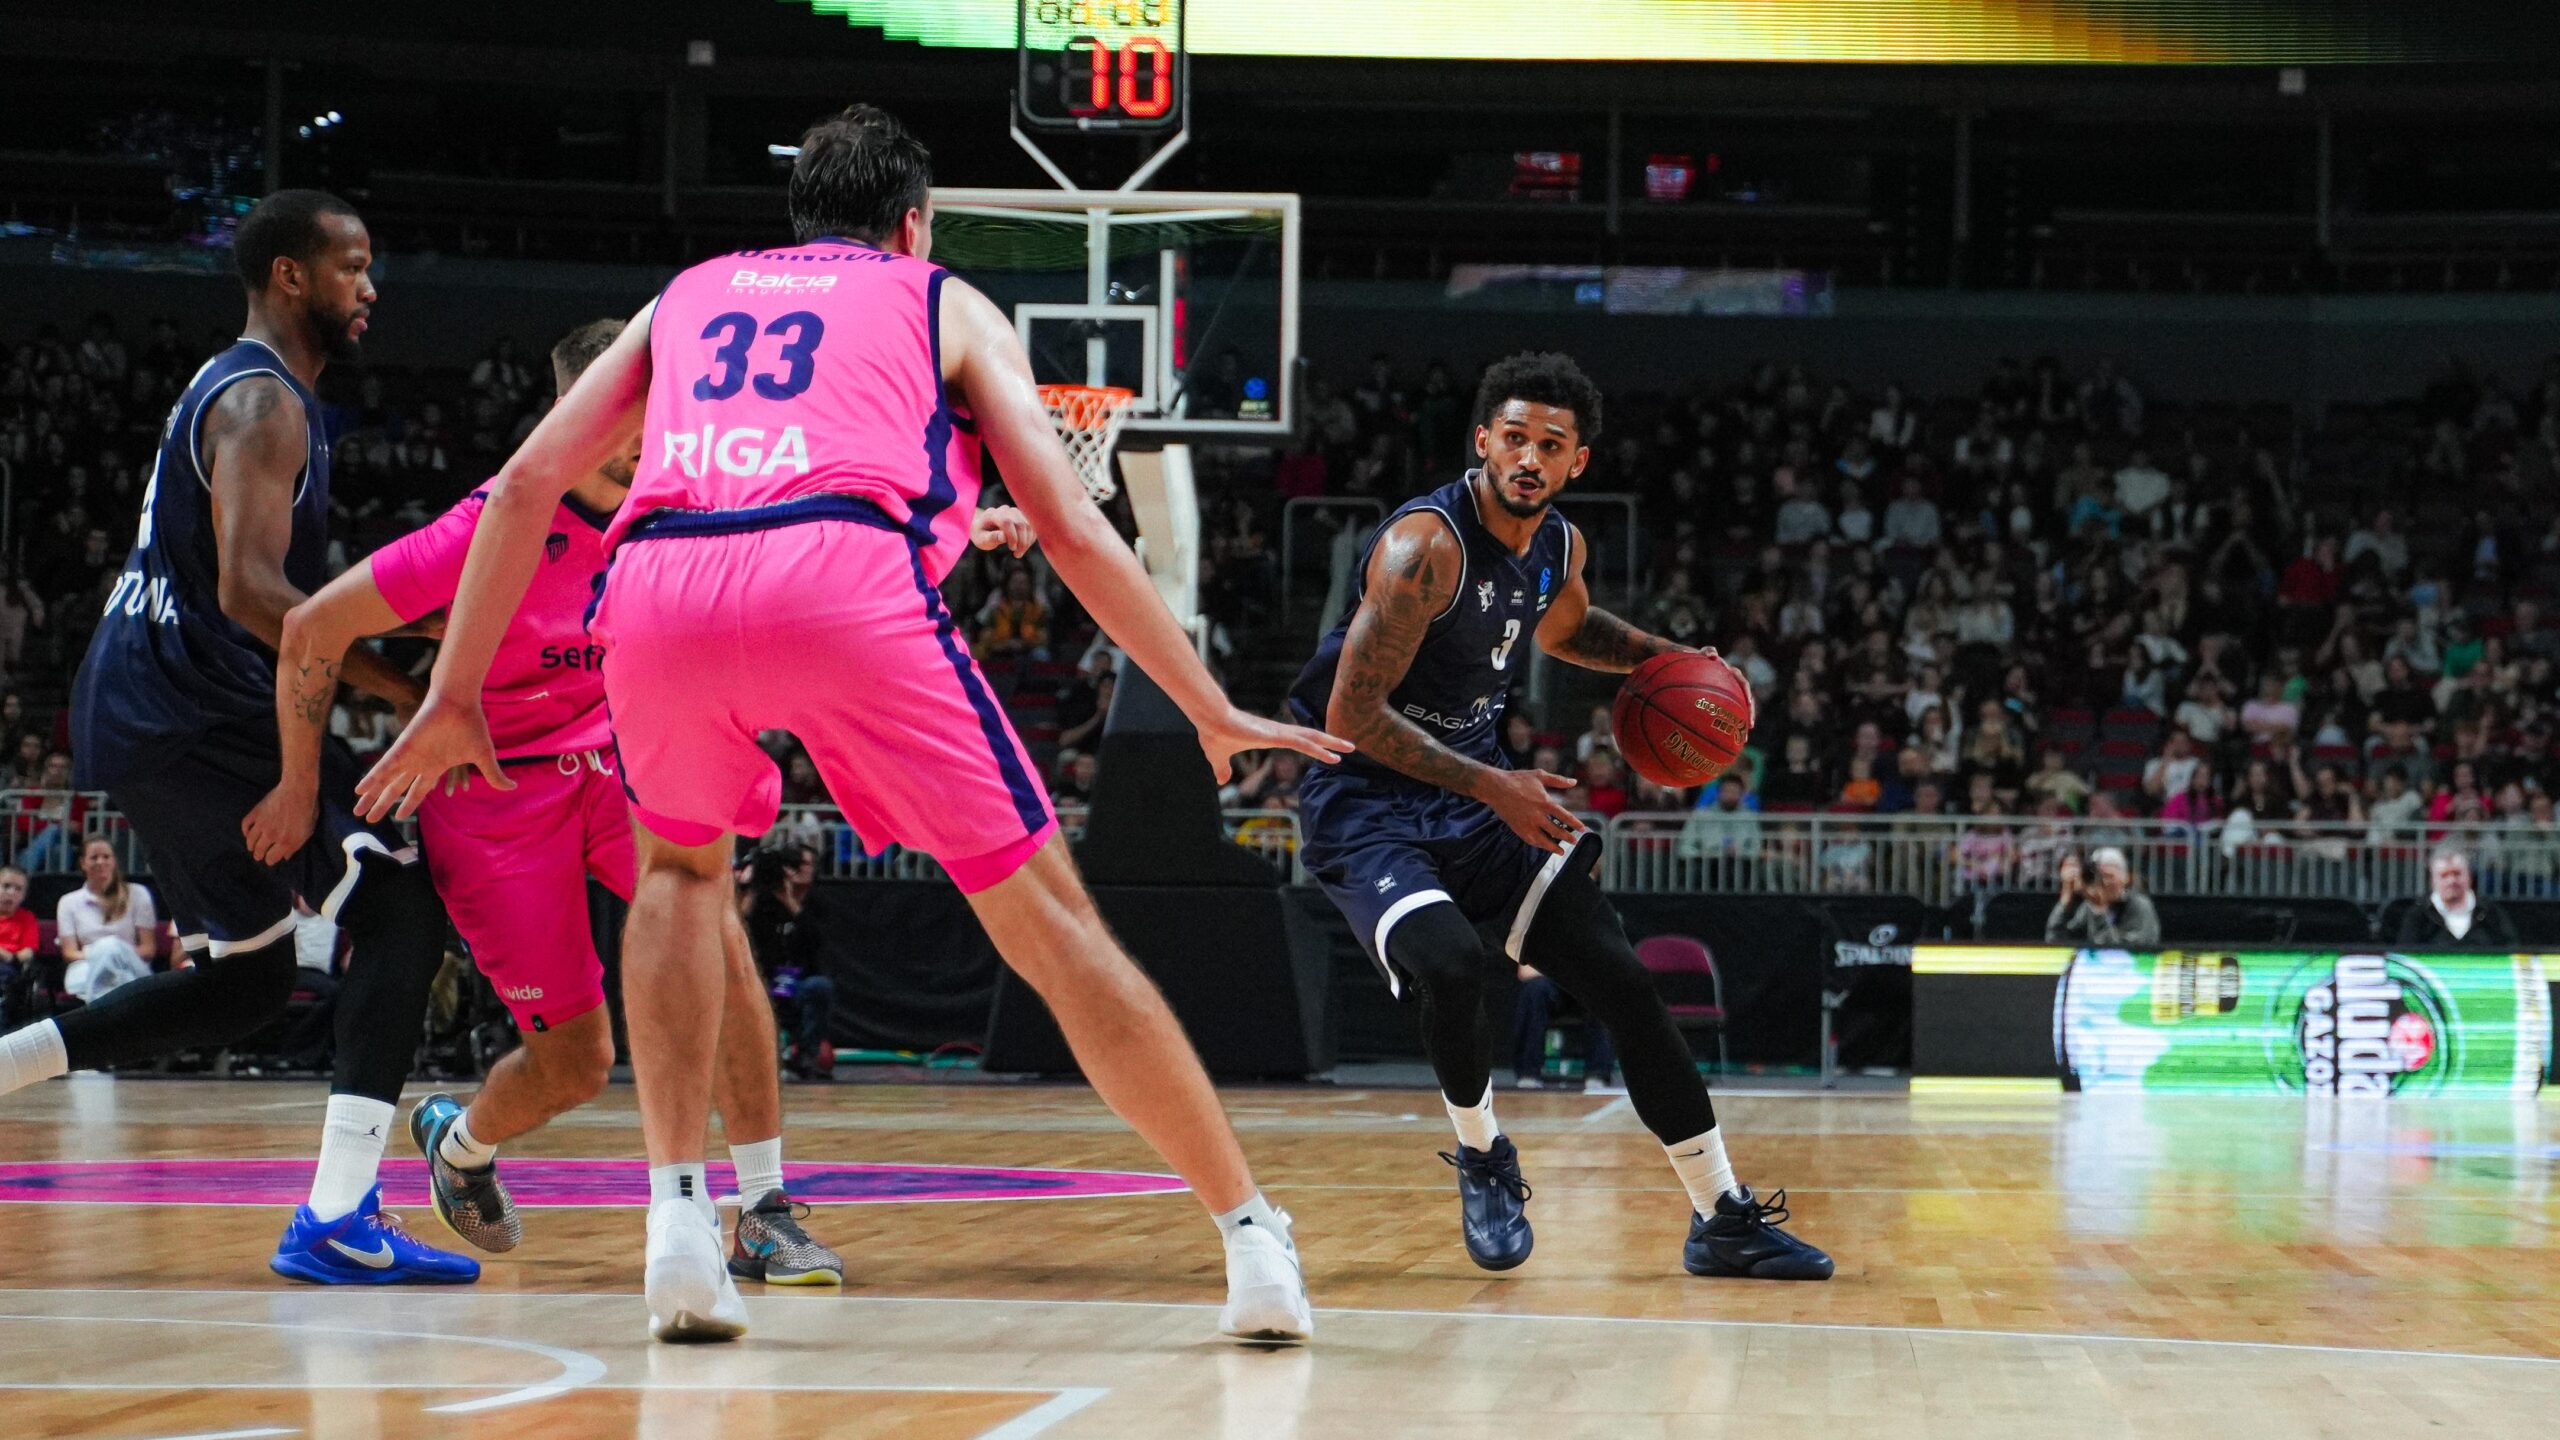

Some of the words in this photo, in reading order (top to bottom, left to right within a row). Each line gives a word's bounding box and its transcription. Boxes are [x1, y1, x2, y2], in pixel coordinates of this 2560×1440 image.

[730, 269, 839, 288] Balcia
[692, 310, 826, 402] 33
[662, 423, 812, 480] RIGA
[1490, 618, 1521, 671] 3
